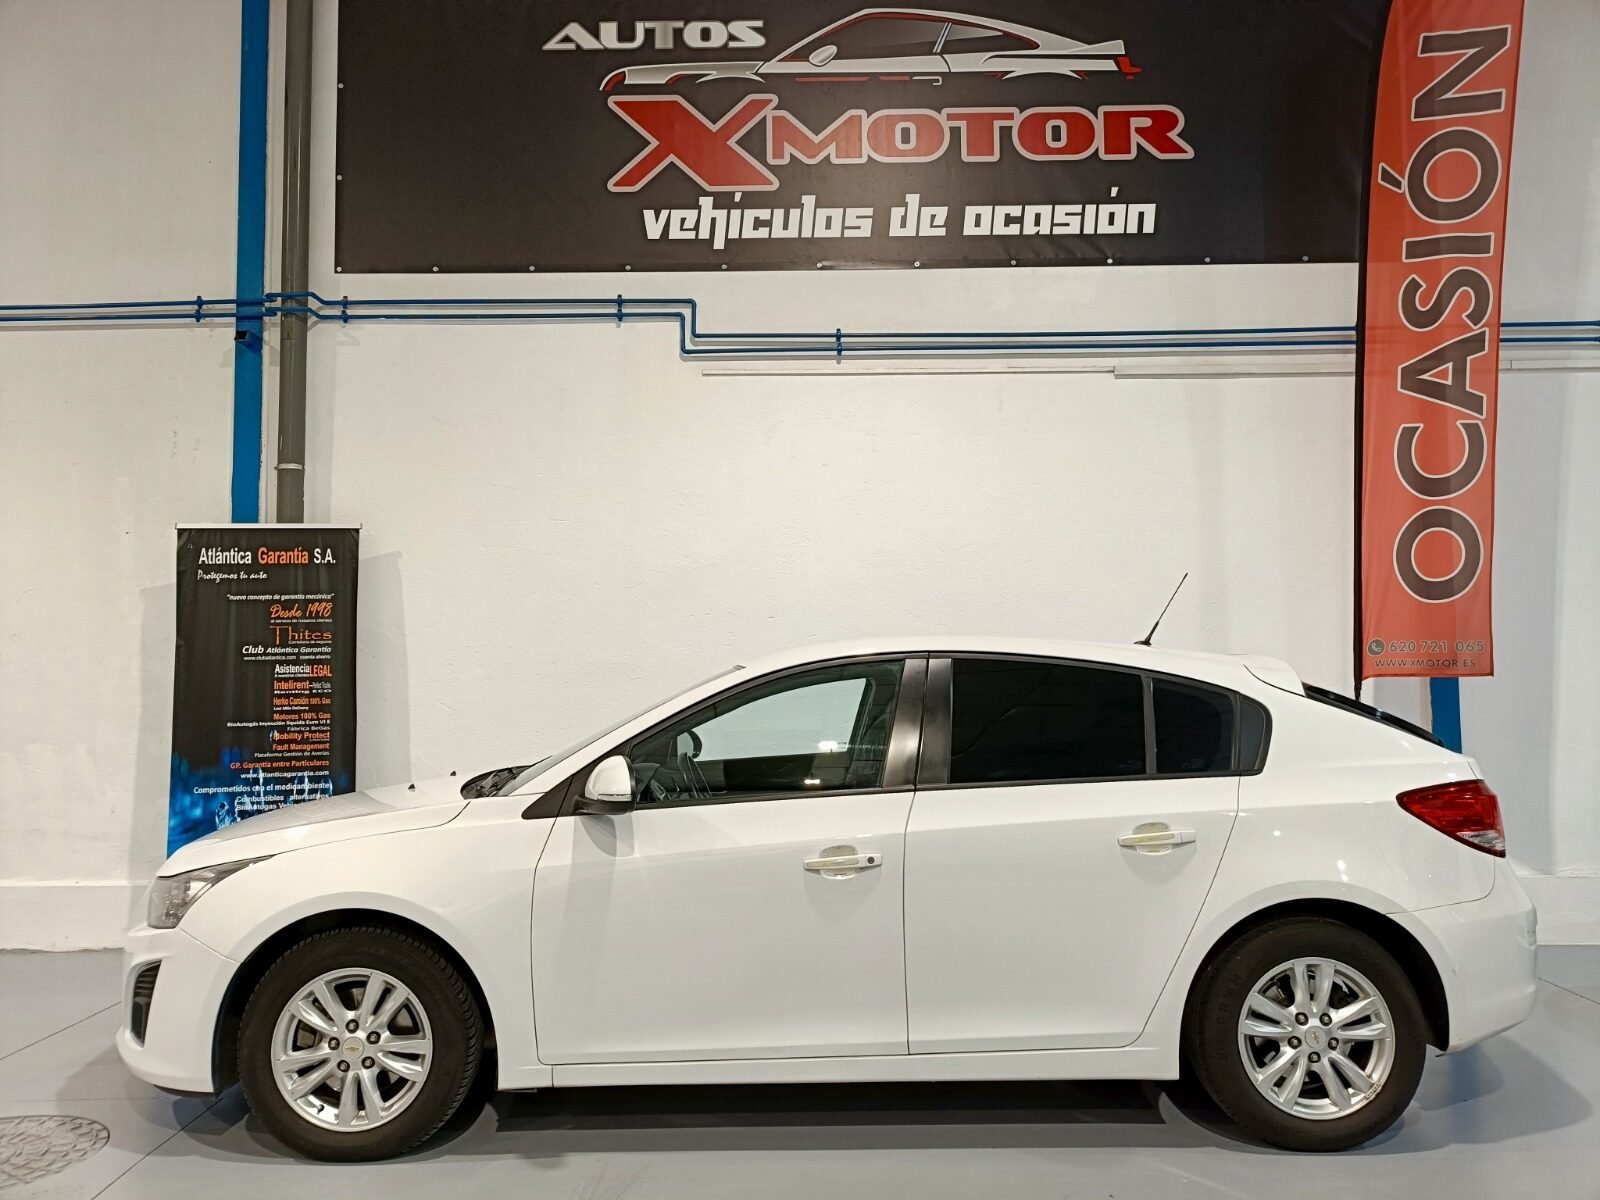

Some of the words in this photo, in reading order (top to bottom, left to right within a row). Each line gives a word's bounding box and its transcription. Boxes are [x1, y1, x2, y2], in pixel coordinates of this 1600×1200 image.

[542, 20, 766, 50] AUTOS
[890, 195, 946, 237] de
[964, 187, 1156, 236] ocasión
[1379, 24, 1511, 604] OCASIÓN
[198, 547, 252, 565] Atlántica
[258, 546, 309, 564] Garantía
[313, 548, 336, 564] S.A.
[197, 569, 238, 583] Protegemos
[240, 571, 248, 579] tu
[250, 570, 267, 579] auto
[270, 603, 302, 618] Desde
[306, 601, 333, 617] 1998
[269, 625, 332, 645] Thites
[242, 645, 264, 654] Club
[266, 646, 298, 654] Atlántica
[300, 645, 331, 653] Garantía
[1389, 640, 1416, 652] 620
[1420, 640, 1449, 653] 721
[1455, 640, 1485, 653] 065
[274, 663, 310, 674] Asistencia
[309, 664, 332, 677] LEGAL
[273, 731, 302, 741] Mobility
[304, 731, 330, 739] Protect
[290, 743, 329, 751] Management
[193, 784, 250, 794] Comprometidos
[267, 783, 273, 791] el
